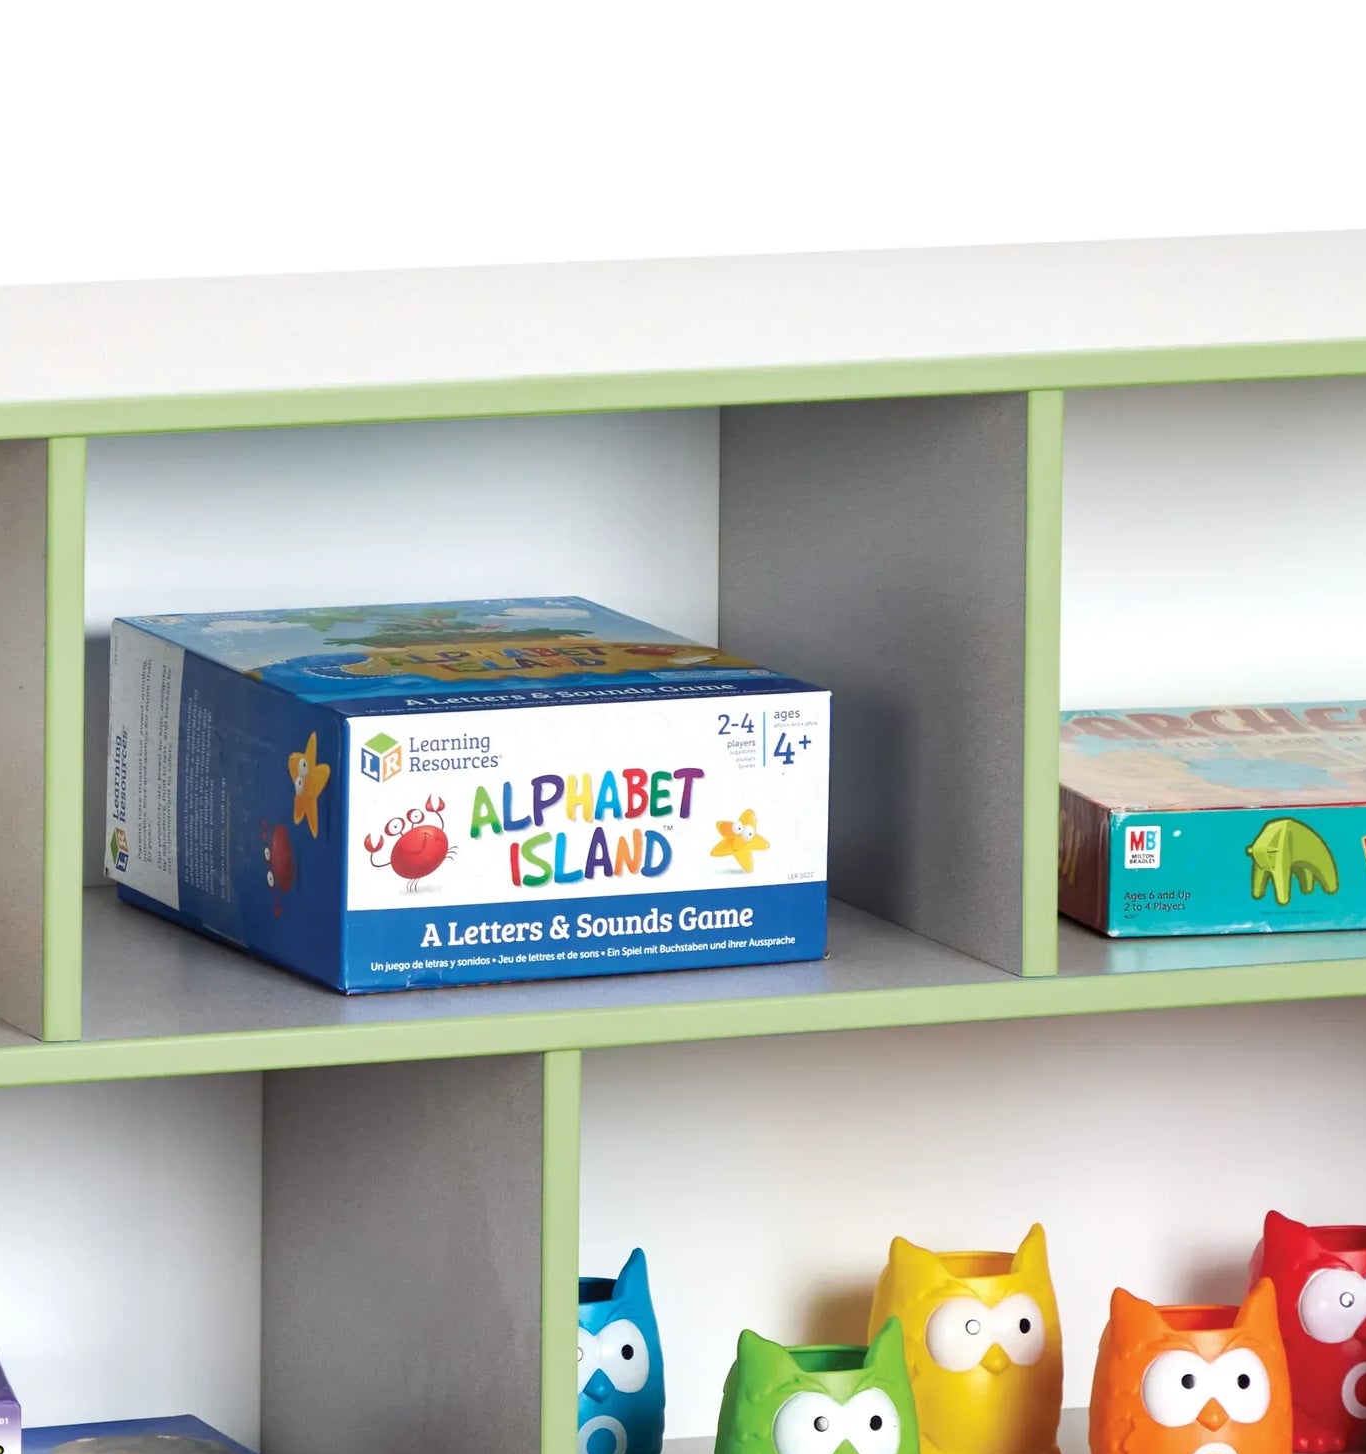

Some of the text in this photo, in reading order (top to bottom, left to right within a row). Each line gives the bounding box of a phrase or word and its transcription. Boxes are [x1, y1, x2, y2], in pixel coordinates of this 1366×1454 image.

[428, 693, 525, 705] Letters
[555, 687, 656, 698] Sounds
[659, 683, 737, 693] Game
[718, 713, 754, 735] 2-4
[774, 710, 800, 721] ages
[409, 733, 490, 753] Learning
[727, 740, 756, 749] players
[409, 754, 499, 772] Resources
[113, 735, 122, 820] Learning
[468, 767, 705, 840] ALPHABET
[1130, 831, 1157, 851] MB
[508, 823, 672, 889] ISLAND
[1124, 890, 1191, 902] Ages 6 and Up
[1124, 902, 1186, 913] 2 to 4 Players
[420, 906, 754, 948] A Letters & Sounds Game
[498, 949, 600, 964] Jeu de lettres et de sons
[607, 935, 796, 958] Ein Spiel mit Buchstaben und ihrer Aussprache
[371, 955, 491, 973] Un juego de letras y sonidos
